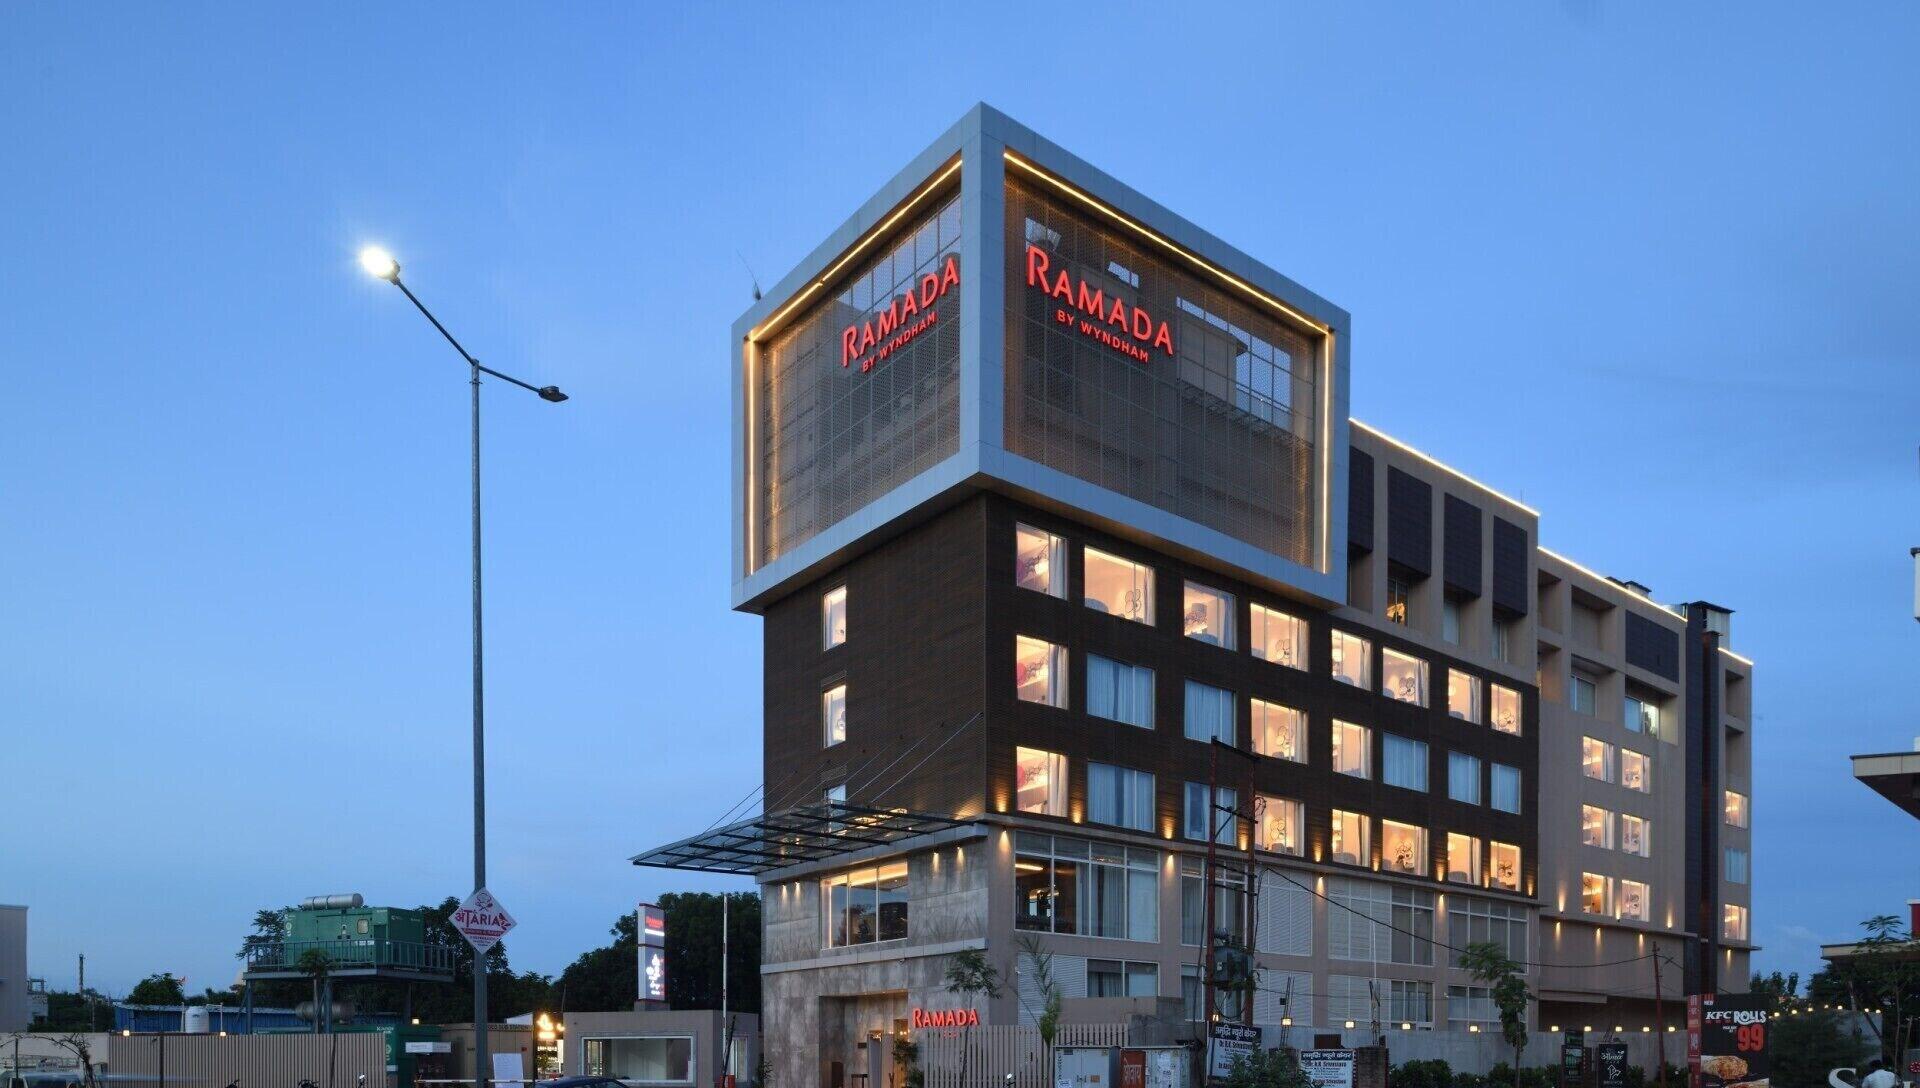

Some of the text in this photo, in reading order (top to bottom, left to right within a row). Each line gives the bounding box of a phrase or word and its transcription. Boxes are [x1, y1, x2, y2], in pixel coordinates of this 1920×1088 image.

[842, 257, 960, 367] RAMADA
[1028, 245, 1174, 356] RAMADA
[862, 312, 937, 373] BY WYNDHAM
[1057, 309, 1149, 363] BY WYNDHAM
[912, 1007, 979, 1028] RAMADA
[1706, 1010, 1766, 1025] KFC ROLLS
[1738, 1024, 1763, 1052] 99
